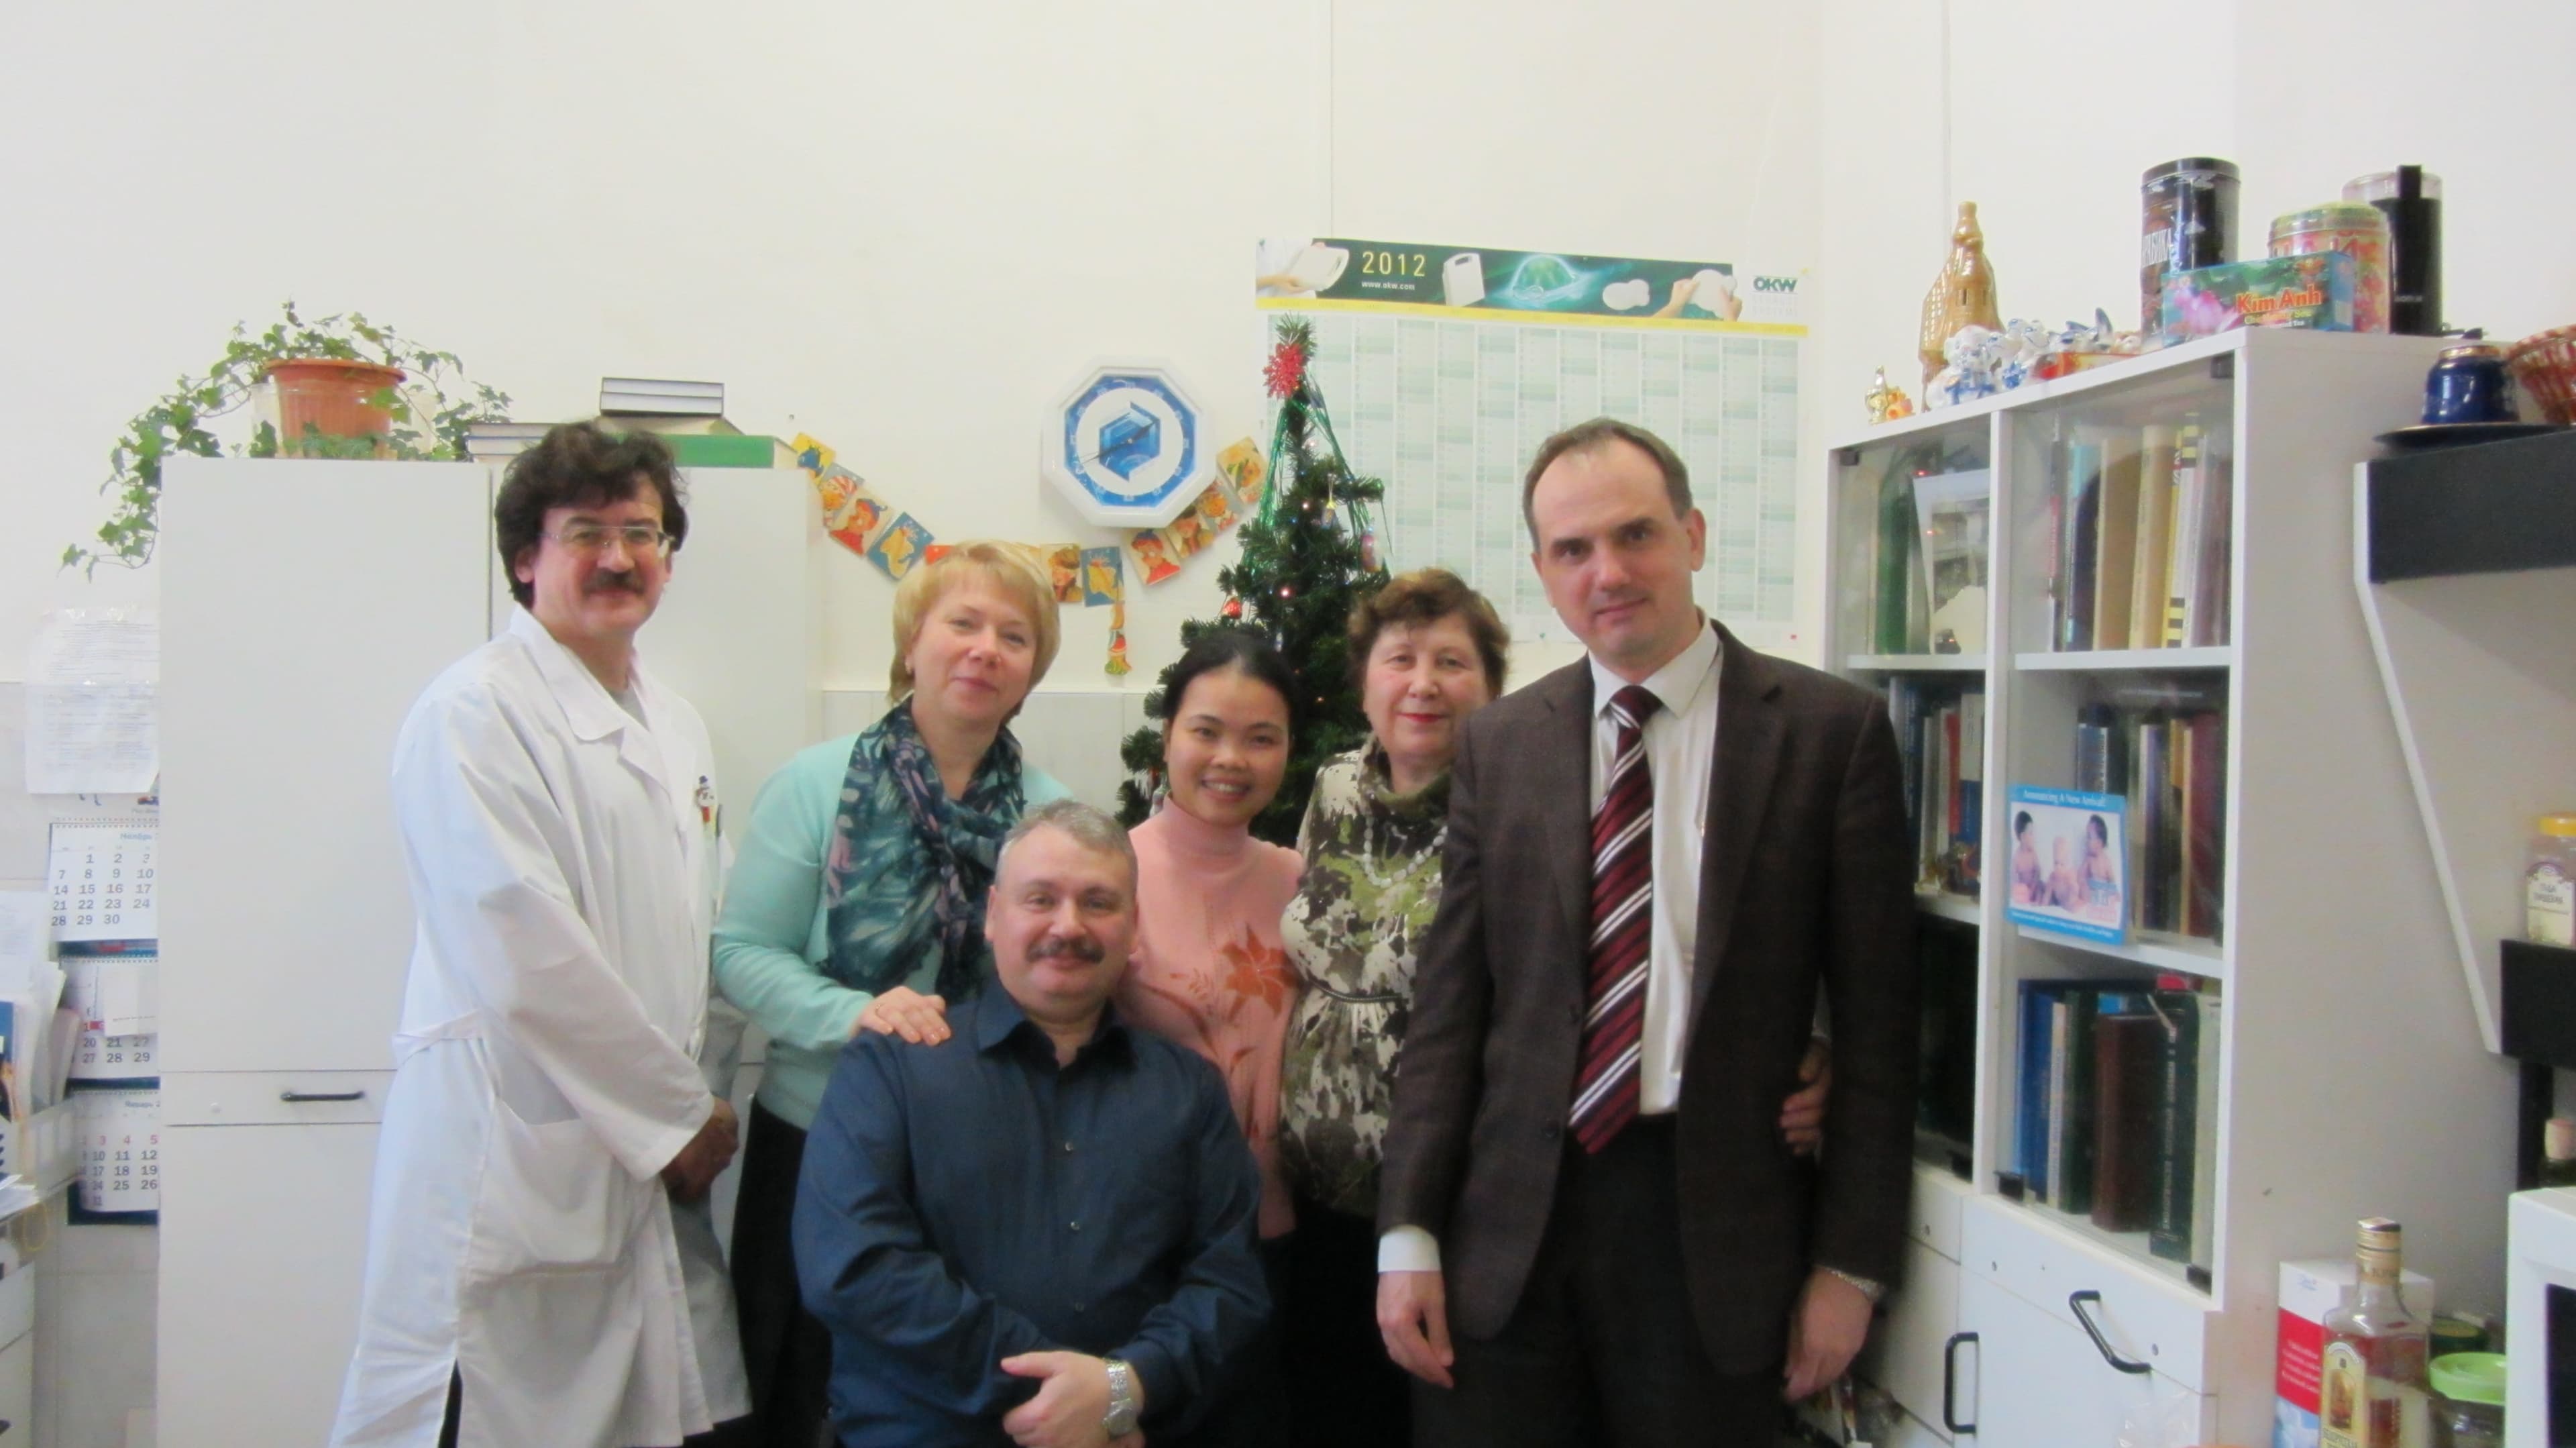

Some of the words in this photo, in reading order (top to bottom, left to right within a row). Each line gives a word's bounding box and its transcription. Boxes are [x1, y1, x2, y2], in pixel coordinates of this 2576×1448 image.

[1362, 252, 1425, 276] 2012
[1362, 281, 1415, 291] www.okw.com
[1753, 276, 1797, 292] OKW
[2236, 293, 2276, 314] Kim
[2279, 284, 2322, 309] Anh
[86, 854, 94, 864] 1
[114, 854, 122, 863] 2
[58, 870, 66, 879] 7
[85, 869, 92, 878] 8
[113, 869, 120, 878] 9
[137, 869, 154, 878] 10
[54, 885, 68, 895] 14
[78, 884, 95, 894] 15
[107, 884, 123, 894] 16
[136, 884, 152, 894] 17
[53, 900, 67, 911] 21
[78, 900, 94, 910] 22
[105, 899, 121, 909] 23
[133, 899, 150, 909] 24
[51, 916, 66, 926] 28
[76, 915, 93, 925] 29
[104, 914, 120, 924] 30
[84, 1038, 97, 1047] 20
[107, 1037, 122, 1047] 21
[83, 1053, 96, 1063] 27
[107, 1053, 123, 1063] 28
[134, 1052, 150, 1062] 29
[123, 1135, 131, 1145] 4
[150, 1135, 158, 1144] 5
[93, 1151, 105, 1160] 10
[115, 1151, 130, 1160] 11
[141, 1150, 157, 1160] 12
[114, 1166, 129, 1176] 18
[141, 1166, 157, 1175] 19
[113, 1181, 129, 1190] 25
[141, 1180, 157, 1190] 26
